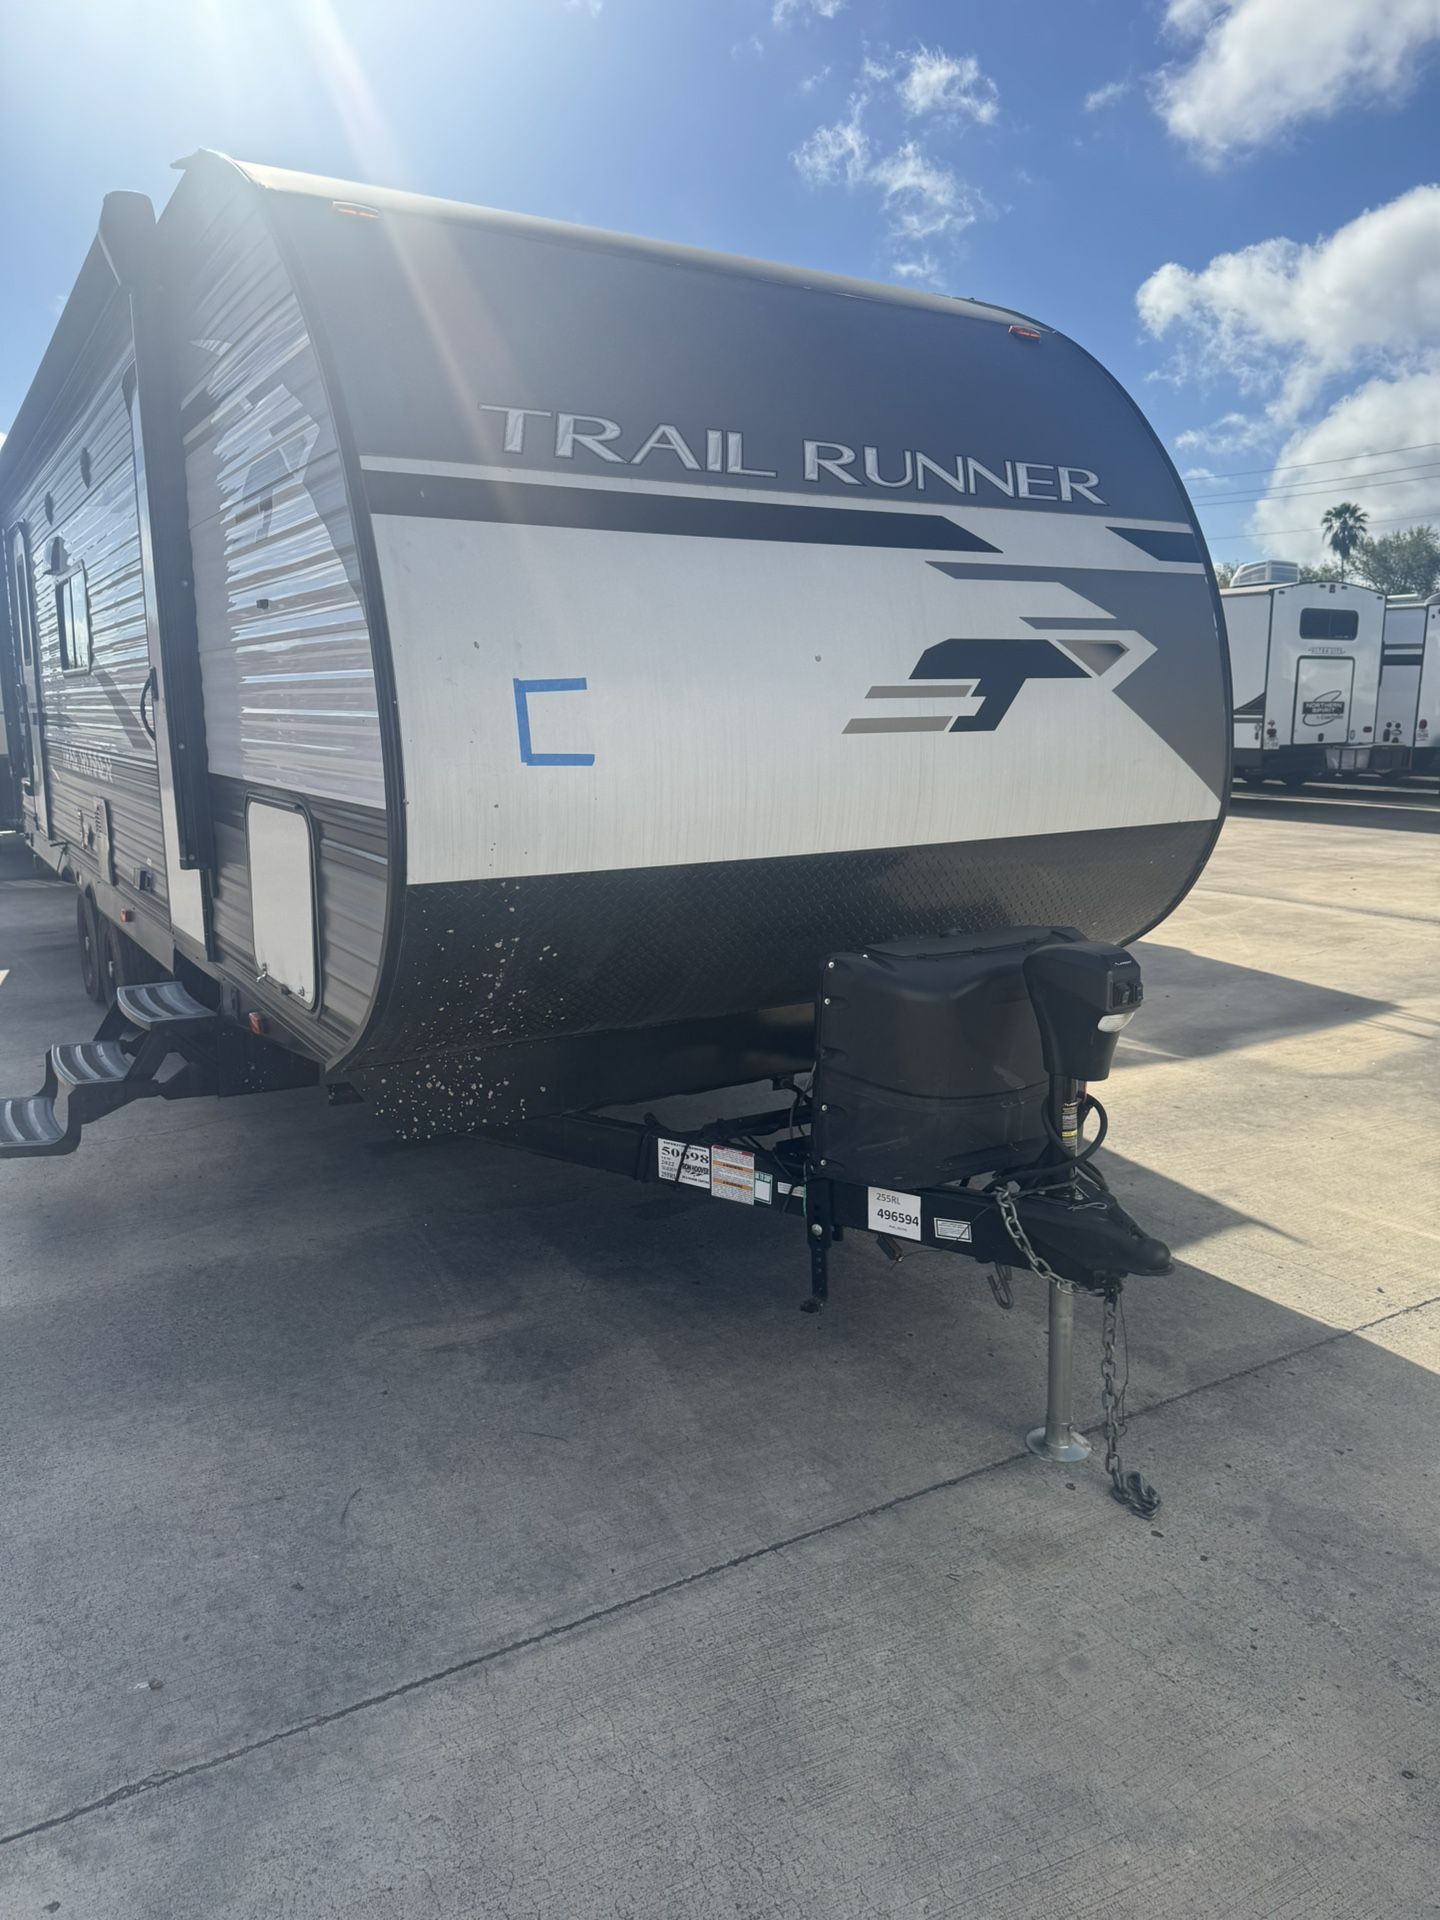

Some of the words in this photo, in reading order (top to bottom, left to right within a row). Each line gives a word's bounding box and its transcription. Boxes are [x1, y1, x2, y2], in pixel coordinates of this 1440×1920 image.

[480, 403, 778, 479] TRAIL
[802, 438, 1108, 506] RUNNER
[876, 1192, 901, 1206] 255RL
[877, 1208, 919, 1227] 496594
